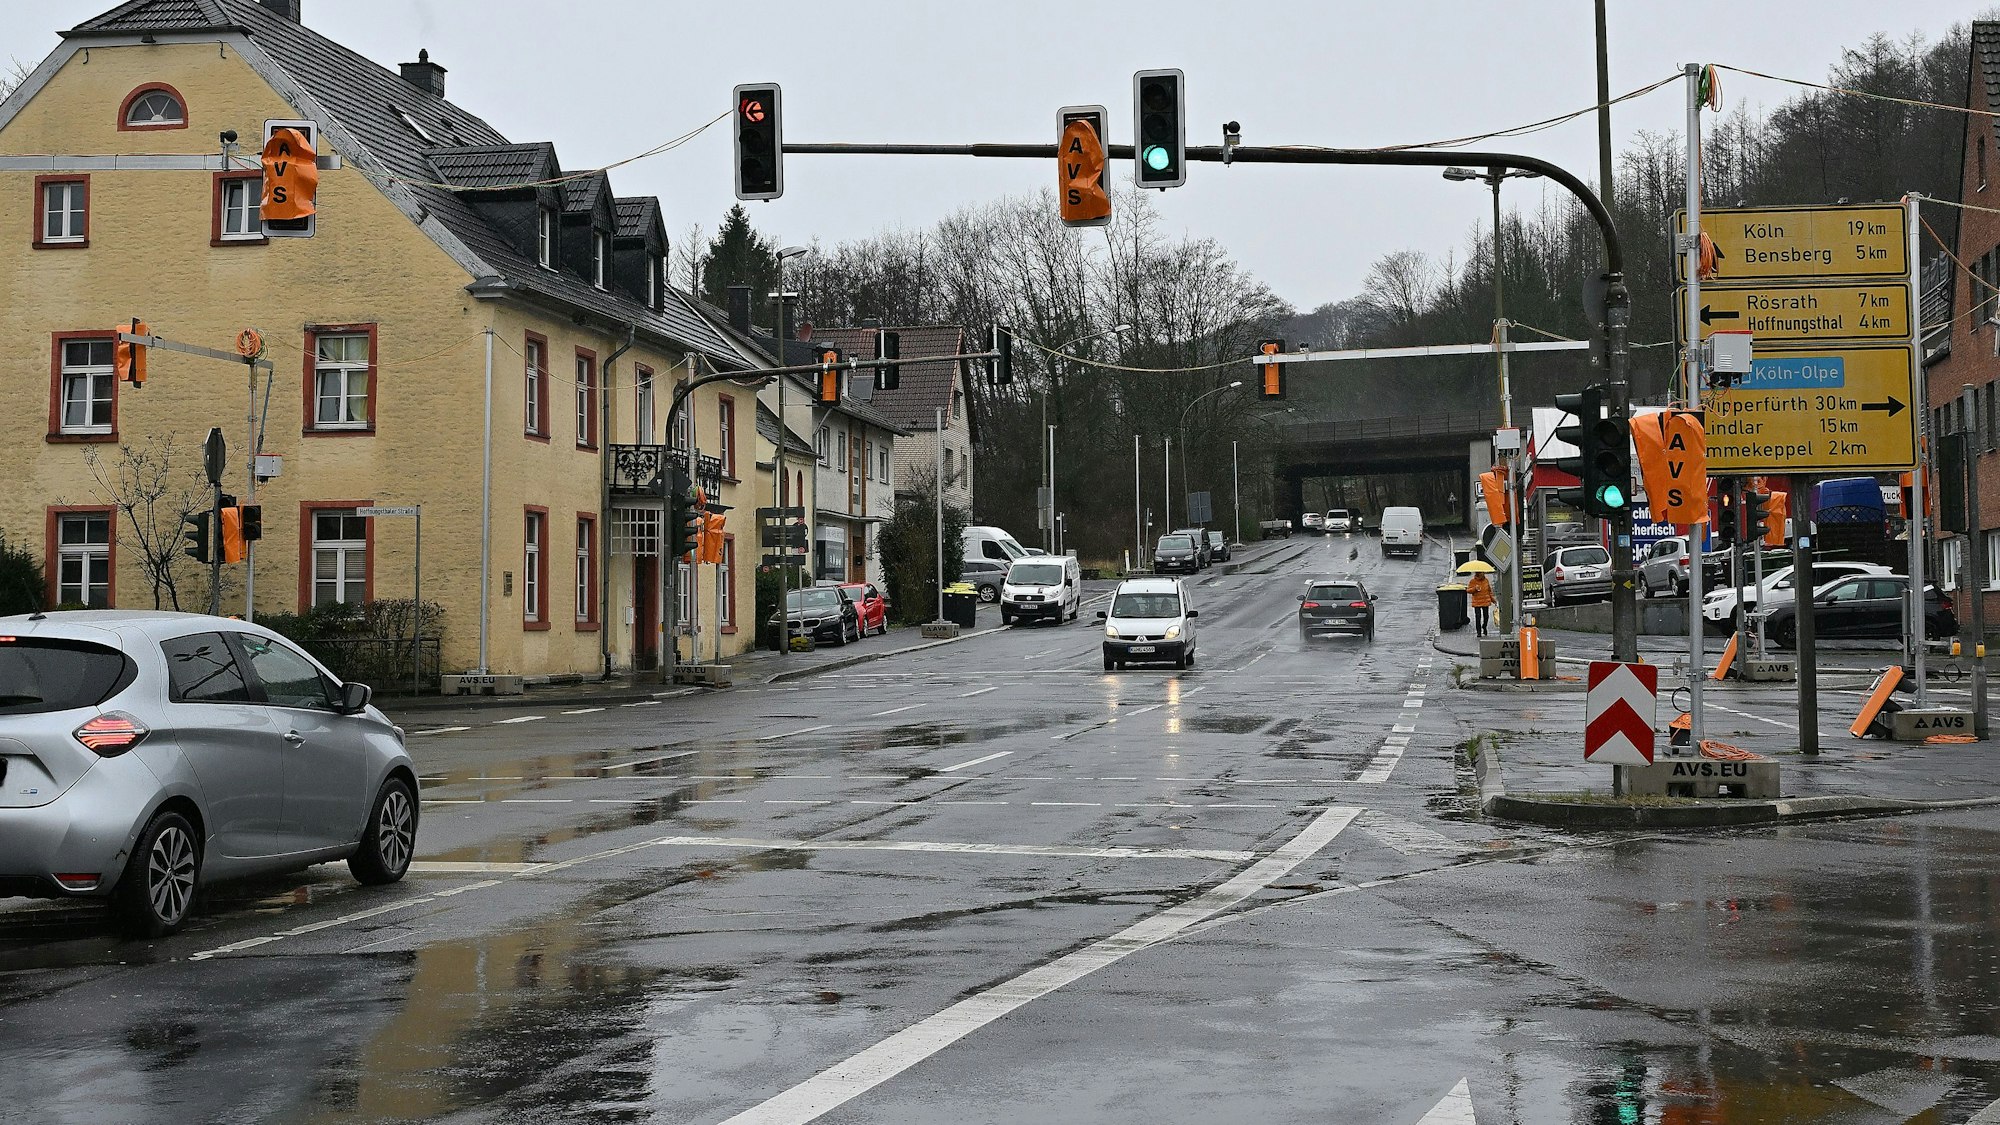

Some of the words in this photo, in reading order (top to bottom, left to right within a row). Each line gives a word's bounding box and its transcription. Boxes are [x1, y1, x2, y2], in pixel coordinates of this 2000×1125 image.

[1744, 223, 1784, 239] Köln
[1848, 220, 1864, 236] 19
[1867, 222, 1886, 235] km
[1745, 247, 1832, 265] Bensberg
[1856, 245, 1866, 260] 5
[1869, 246, 1887, 259] km
[1747, 294, 1818, 310] Rösrath
[1858, 293, 1868, 308] 7
[1871, 294, 1889, 308] km
[1748, 314, 1843, 334] Hoffnungsthal
[1859, 314, 1869, 329] 4
[1872, 315, 1890, 329] km
[1755, 365, 1839, 382] Köln-Olpe
[1815, 396, 1836, 411] 30
[1839, 397, 1857, 410] km
[1820, 418, 1837, 433] 15
[1840, 420, 1858, 433] km
[1706, 441, 1813, 460] mmekeppel
[1828, 441, 1838, 455] 2
[1841, 440, 1867, 455] km
[1667, 433, 1687, 507] AVS
[674, 666, 706, 674] AVS.EU
[1767, 664, 1789, 673] AVS
[459, 676, 495, 684] AVS.EU
[1932, 716, 1964, 728] AVS
[1672, 762, 1747, 777] AVS.EU
